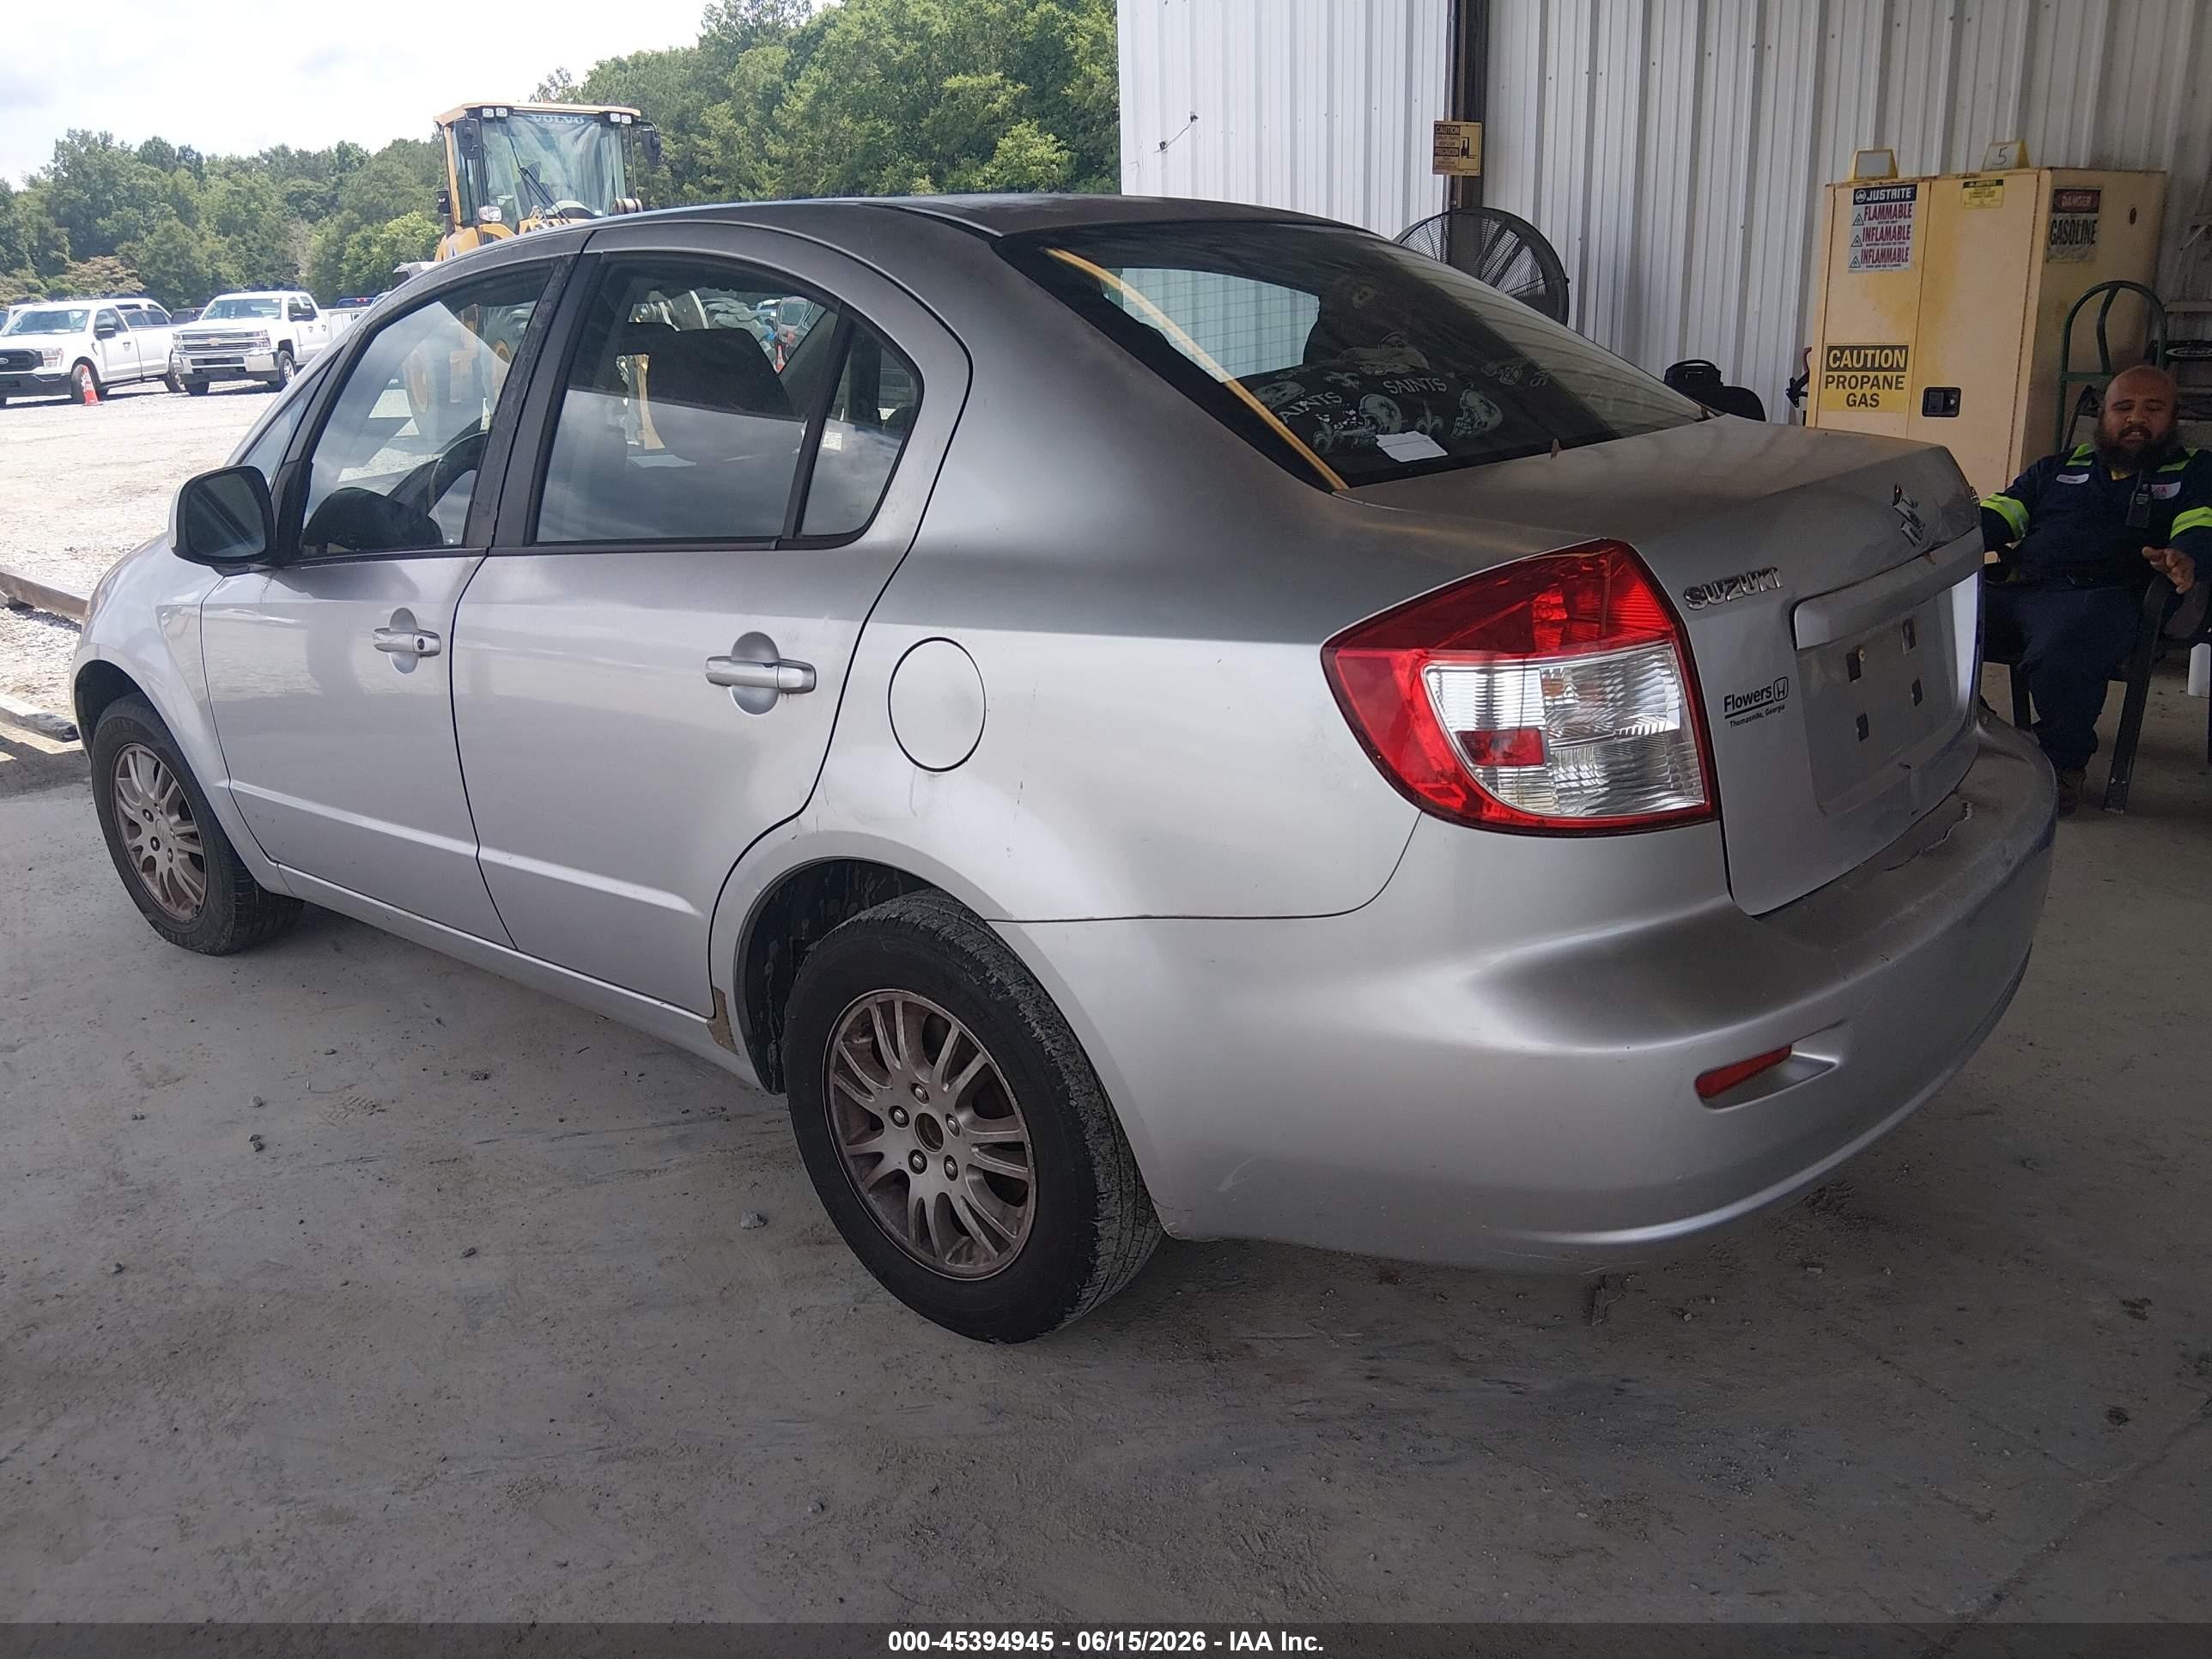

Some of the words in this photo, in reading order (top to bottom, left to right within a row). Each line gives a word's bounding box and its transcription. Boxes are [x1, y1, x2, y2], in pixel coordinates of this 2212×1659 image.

[532, 115, 585, 125] VOLVO
[1435, 125, 1460, 134] CAUTION
[1993, 147, 2008, 166] 5
[1867, 188, 1912, 201] JUSTRITE
[2062, 195, 2092, 207] DANGER
[1864, 203, 1912, 222] FLAMMABLE
[1863, 224, 1911, 242] INFLAMABLE
[2050, 219, 2097, 246] GASOLINE
[1861, 246, 1910, 264] INFLAMMABLE
[1829, 349, 1905, 368] CAUTION
[1383, 377, 1447, 394] SAINTS
[1825, 375, 1905, 390] PROPANE
[1846, 392, 1880, 408] GAS
[1684, 568, 1781, 609] SUZUKI
[1724, 685, 1771, 713] Flowers
